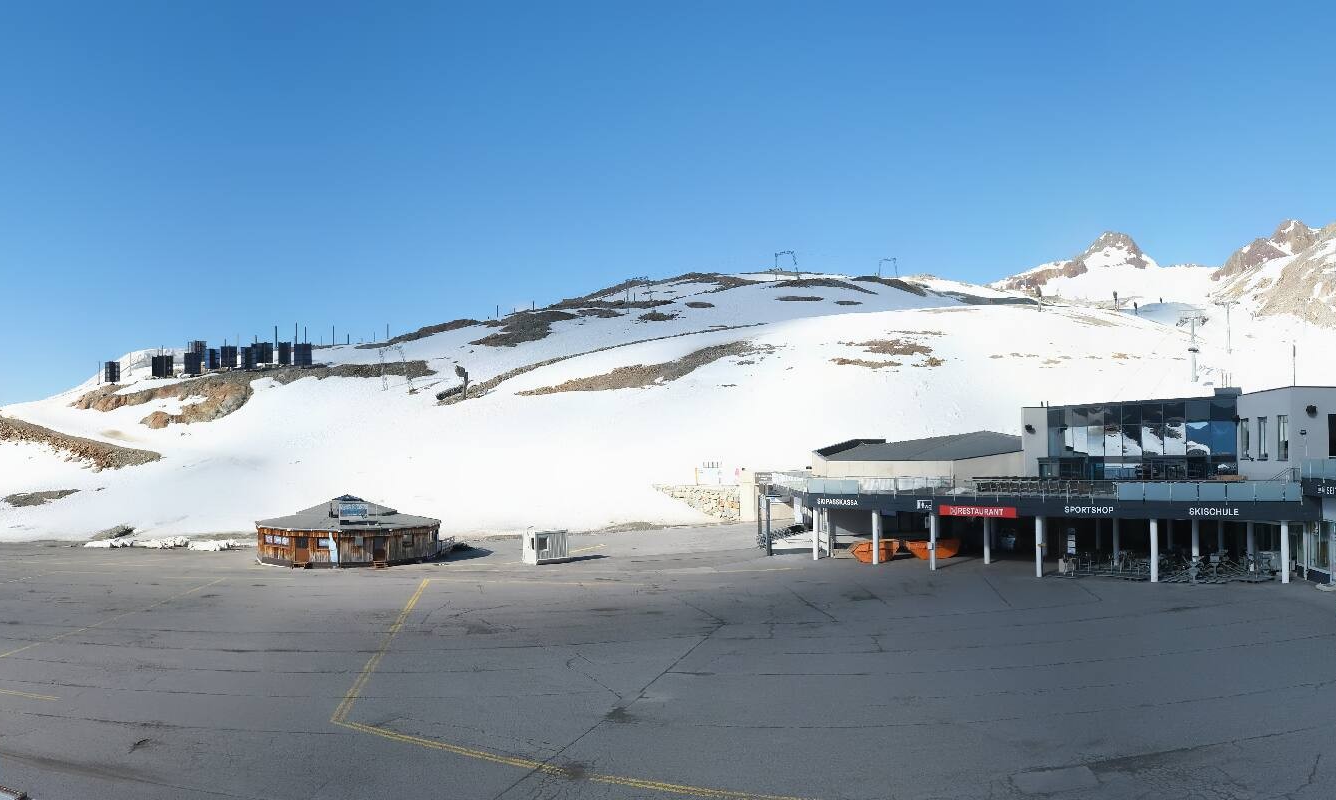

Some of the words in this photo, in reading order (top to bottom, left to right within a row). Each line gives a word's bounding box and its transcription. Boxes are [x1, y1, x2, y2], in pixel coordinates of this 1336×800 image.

[957, 507, 1004, 516] RESTAURANT
[1064, 506, 1114, 514] SPORTSHOP
[1189, 507, 1239, 516] SKISCHULE
